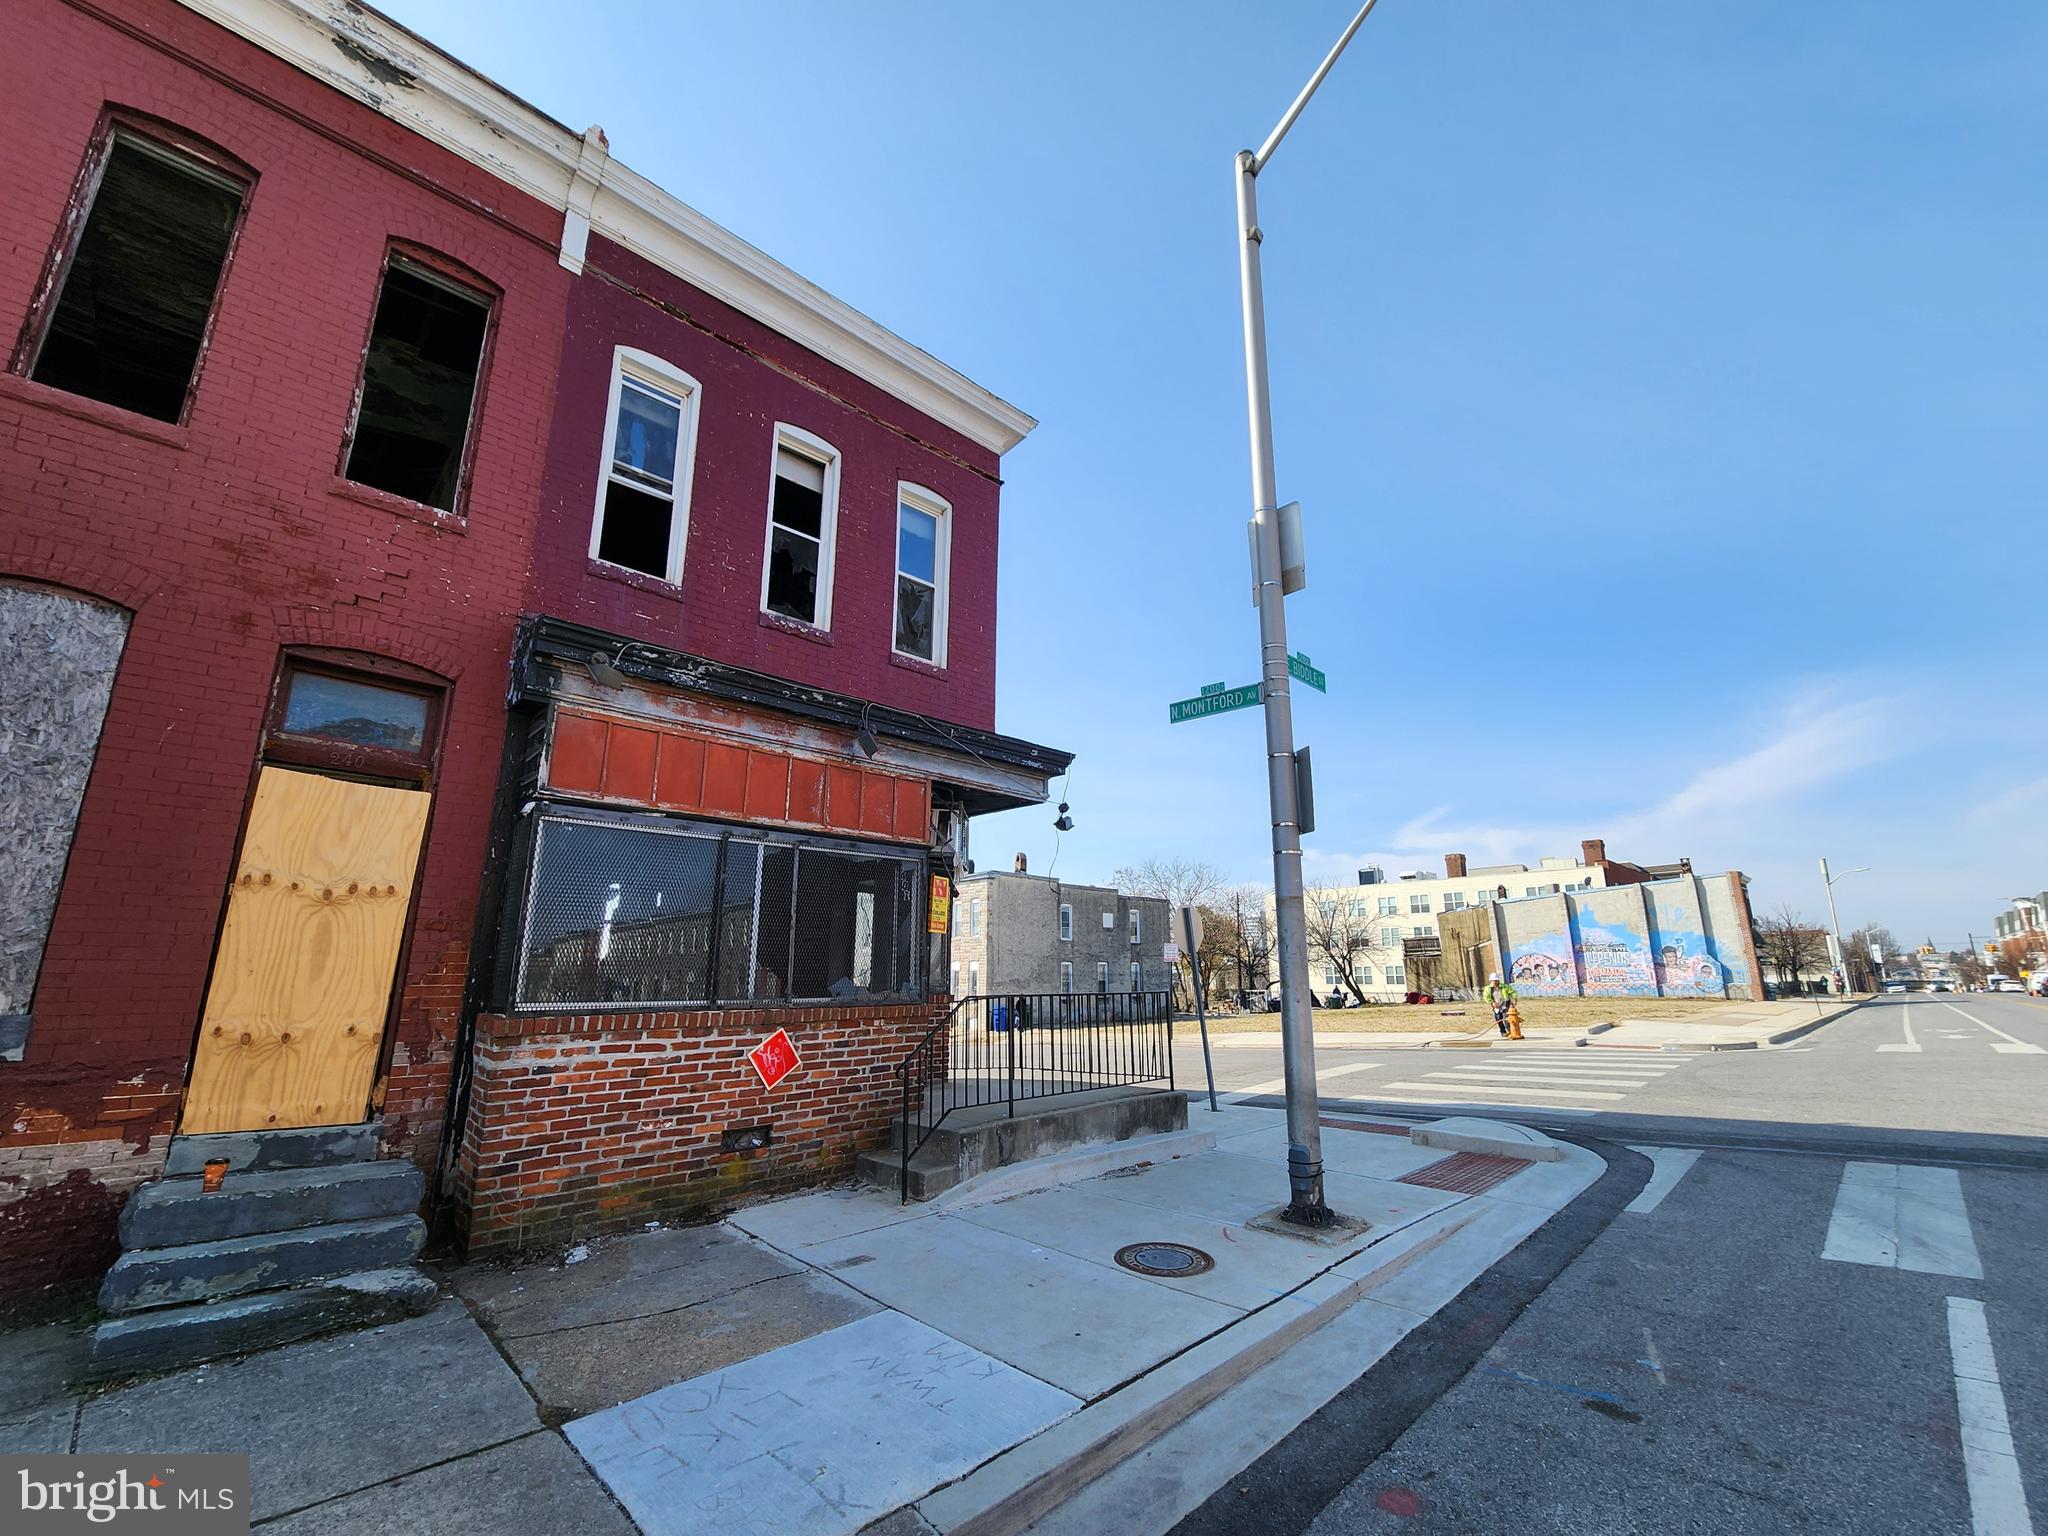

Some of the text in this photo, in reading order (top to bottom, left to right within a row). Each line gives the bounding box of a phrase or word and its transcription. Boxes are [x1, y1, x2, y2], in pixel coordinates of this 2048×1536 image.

[1293, 661, 1318, 686] BIDDLE
[1201, 683, 1221, 695] 1200
[1183, 692, 1243, 714] MONTFORD
